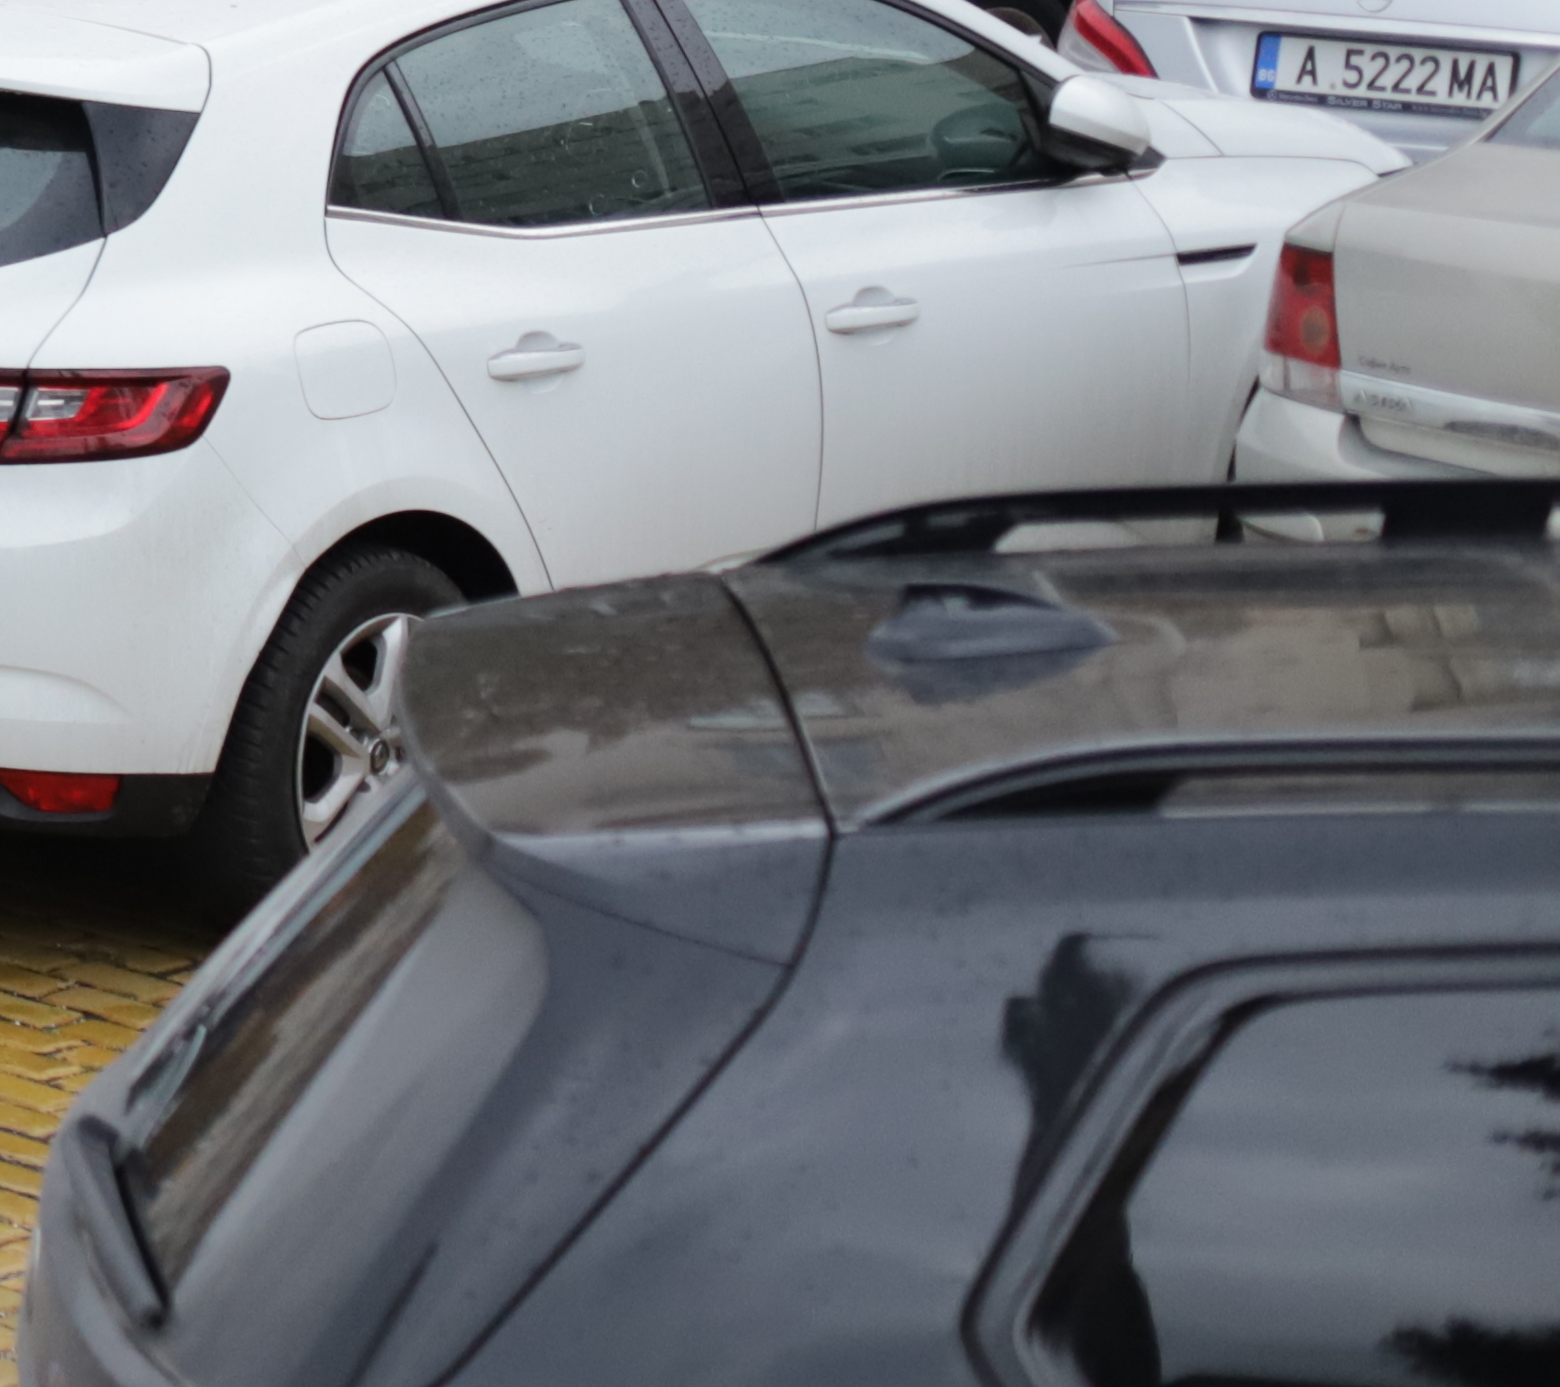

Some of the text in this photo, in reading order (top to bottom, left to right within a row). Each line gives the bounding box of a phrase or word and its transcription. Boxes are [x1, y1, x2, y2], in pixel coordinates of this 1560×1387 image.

[1295, 45, 1318, 86] A
[1342, 48, 1441, 96] 5222
[1448, 57, 1499, 103] MA
